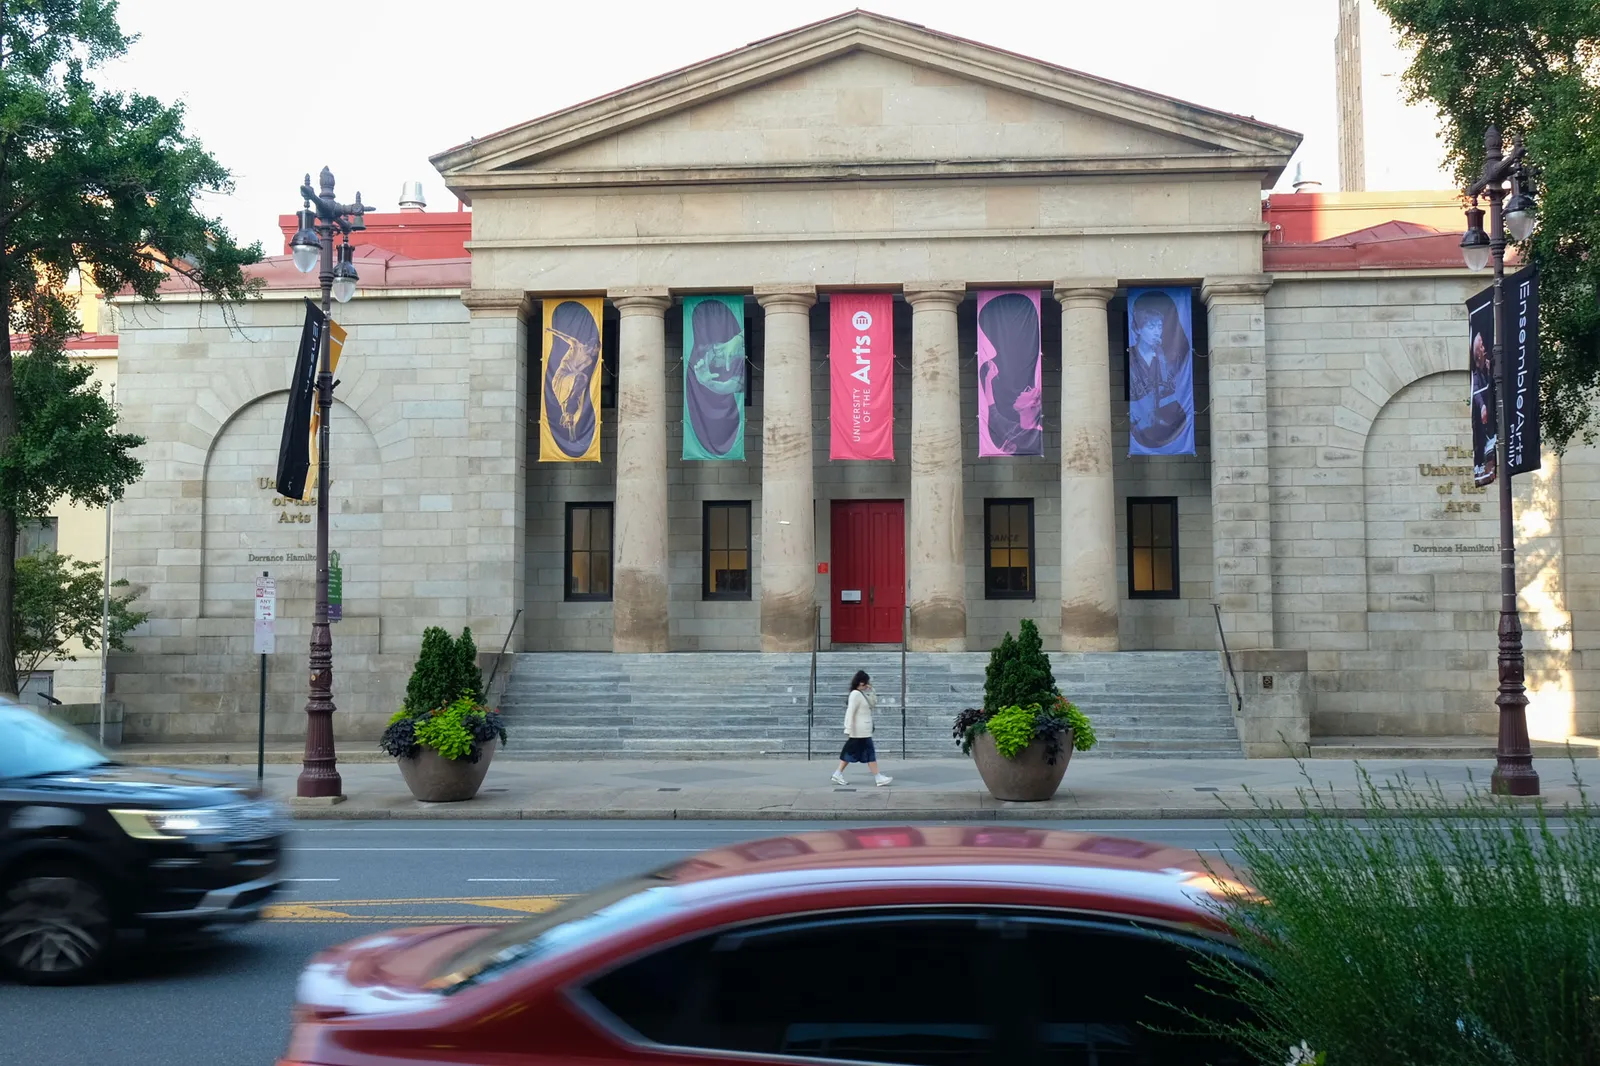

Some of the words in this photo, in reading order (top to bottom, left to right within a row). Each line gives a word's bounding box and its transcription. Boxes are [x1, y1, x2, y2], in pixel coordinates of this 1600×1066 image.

[850, 335, 871, 385] Arts
[863, 389, 871, 407] THE
[852, 387, 861, 442] UNIVERSITY
[863, 411, 871, 423] OF
[1506, 425, 1515, 468] Philly
[1419, 464, 1474, 476] Univer
[1436, 482, 1453, 494] of
[1444, 500, 1481, 513] Arts
[278, 511, 311, 523] Arts
[1413, 544, 1453, 553] Dorrance
[1455, 544, 1495, 553] Hamilton
[248, 553, 284, 562] Dorrance
[286, 553, 318, 562] Hamilto
